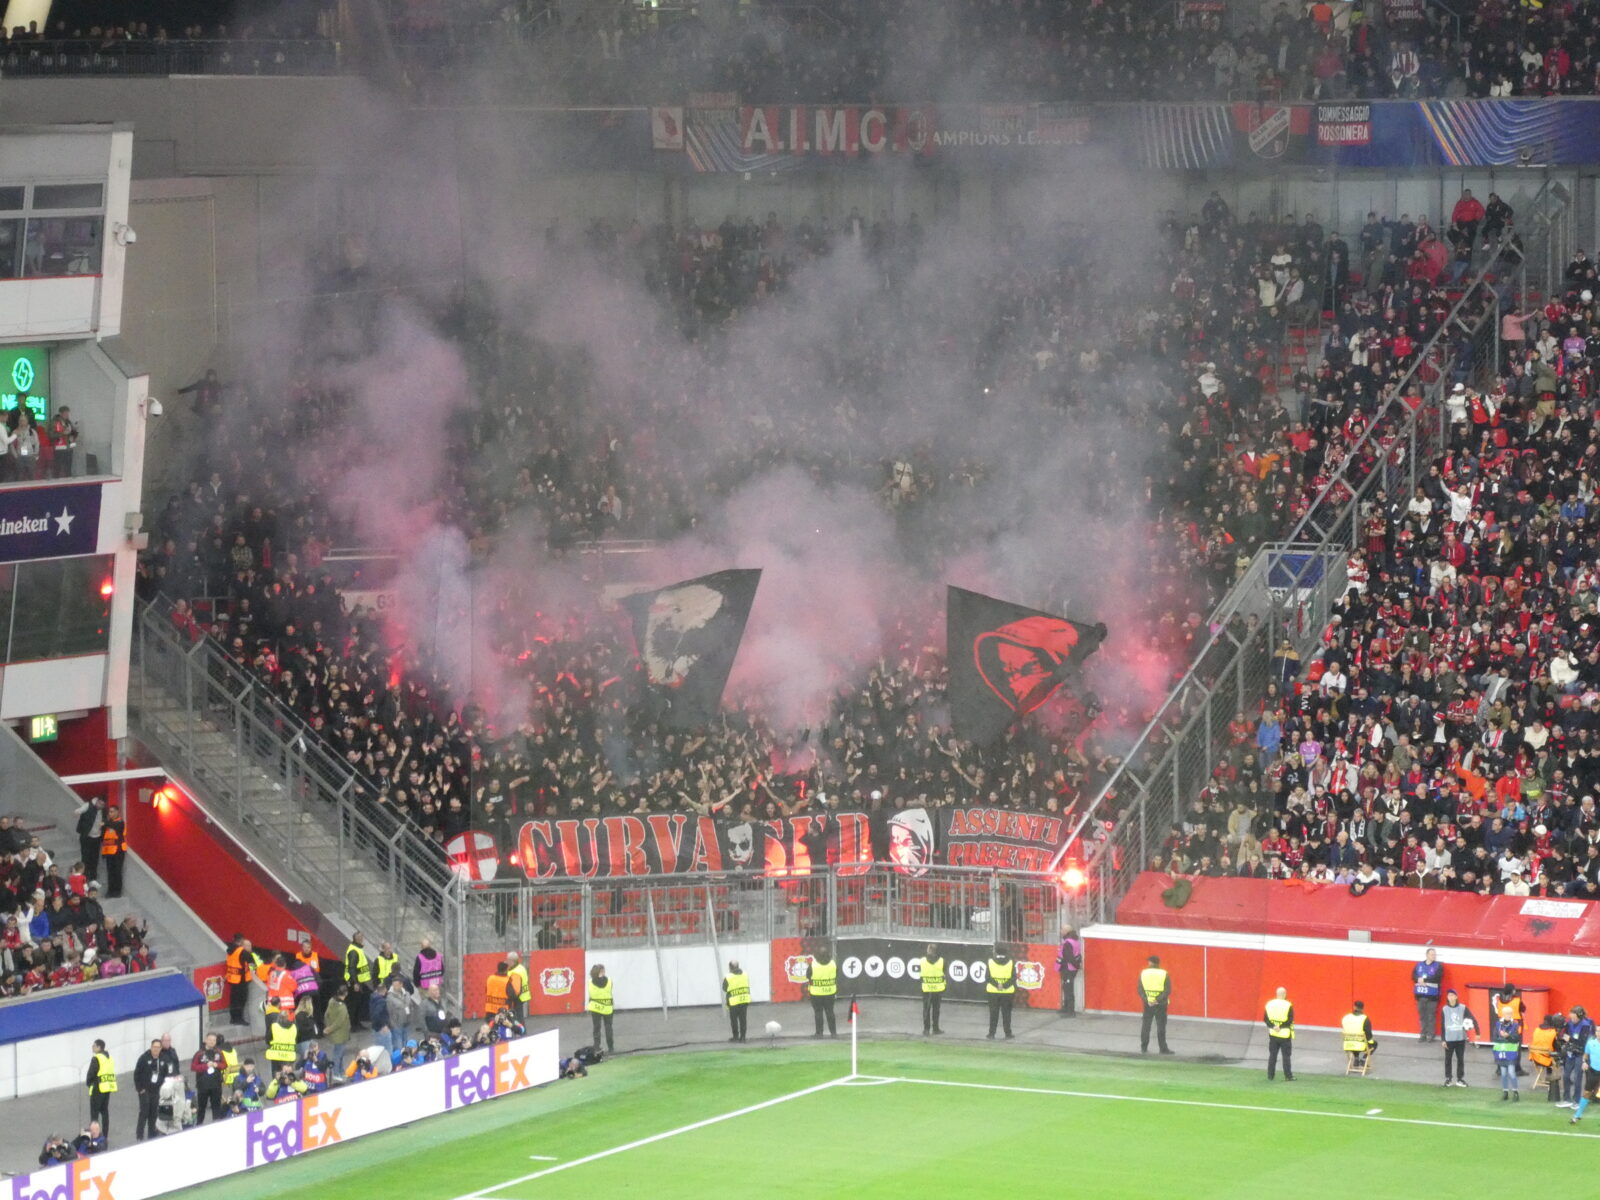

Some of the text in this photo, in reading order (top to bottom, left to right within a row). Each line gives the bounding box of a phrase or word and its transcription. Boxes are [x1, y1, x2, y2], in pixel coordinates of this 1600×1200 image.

[932, 130, 1010, 146] AMPIONS
[1319, 123, 1369, 141] ROSSONERA
[0, 516, 48, 536] ineken
[948, 808, 1063, 845] ASSENTI
[518, 814, 727, 880] CURVA
[947, 841, 1054, 873] PRESENTI
[444, 1041, 531, 1110] FedEx
[246, 1095, 343, 1168] FedEx
